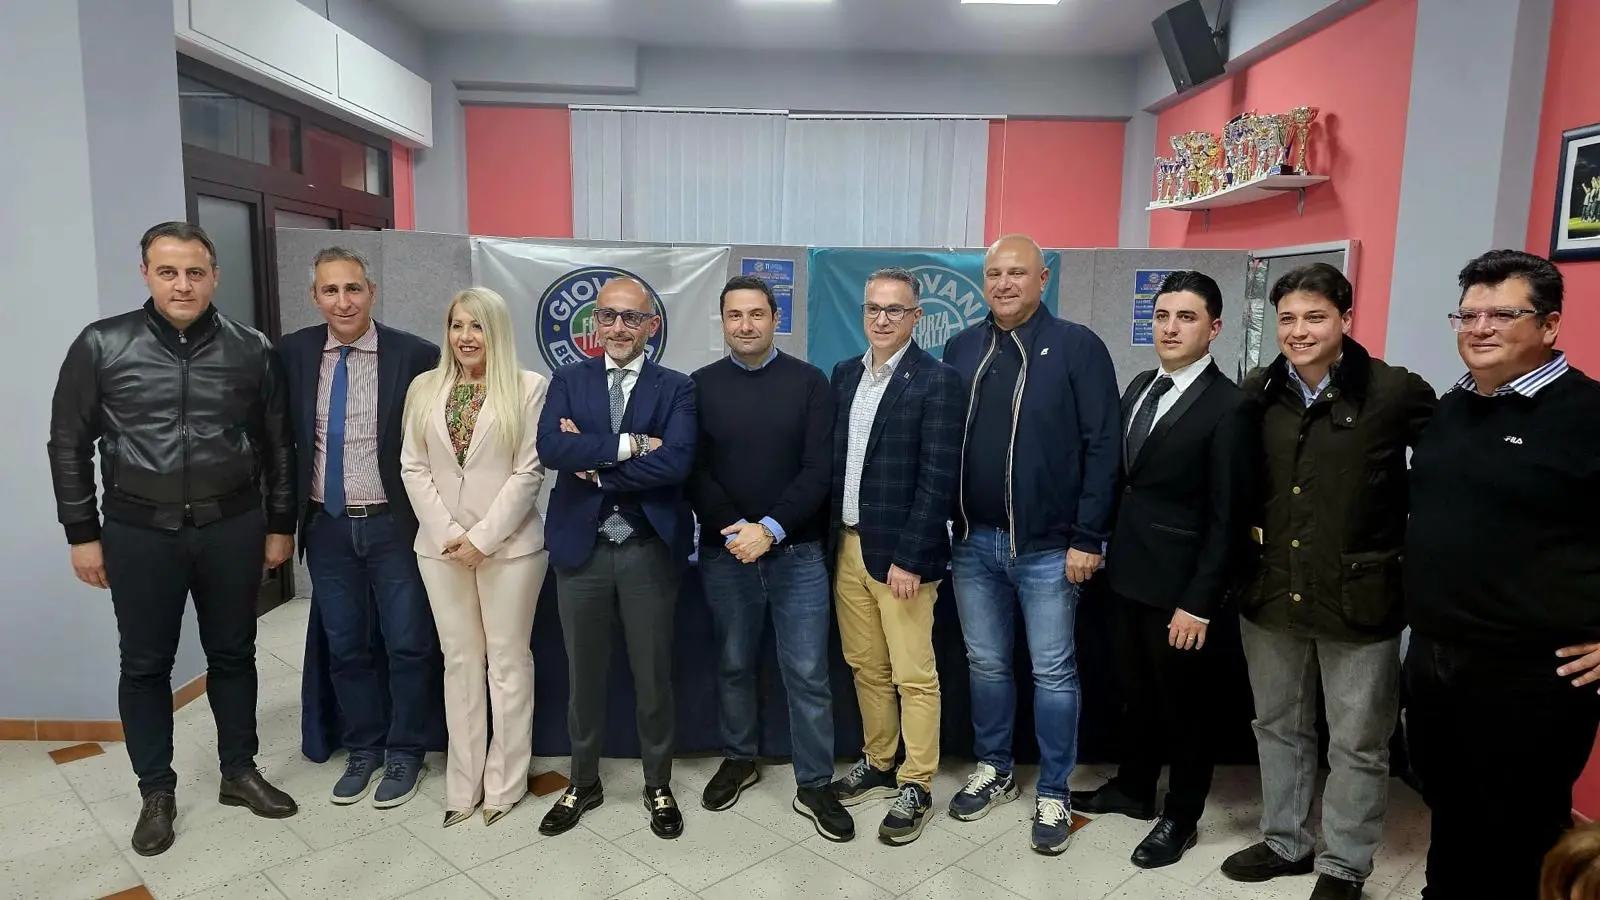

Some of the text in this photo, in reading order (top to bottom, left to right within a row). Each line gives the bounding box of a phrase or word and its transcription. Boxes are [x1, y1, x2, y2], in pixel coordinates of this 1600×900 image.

[549, 277, 612, 321] GIOV
[915, 311, 949, 331] ORZA
[917, 273, 986, 326] VANI
